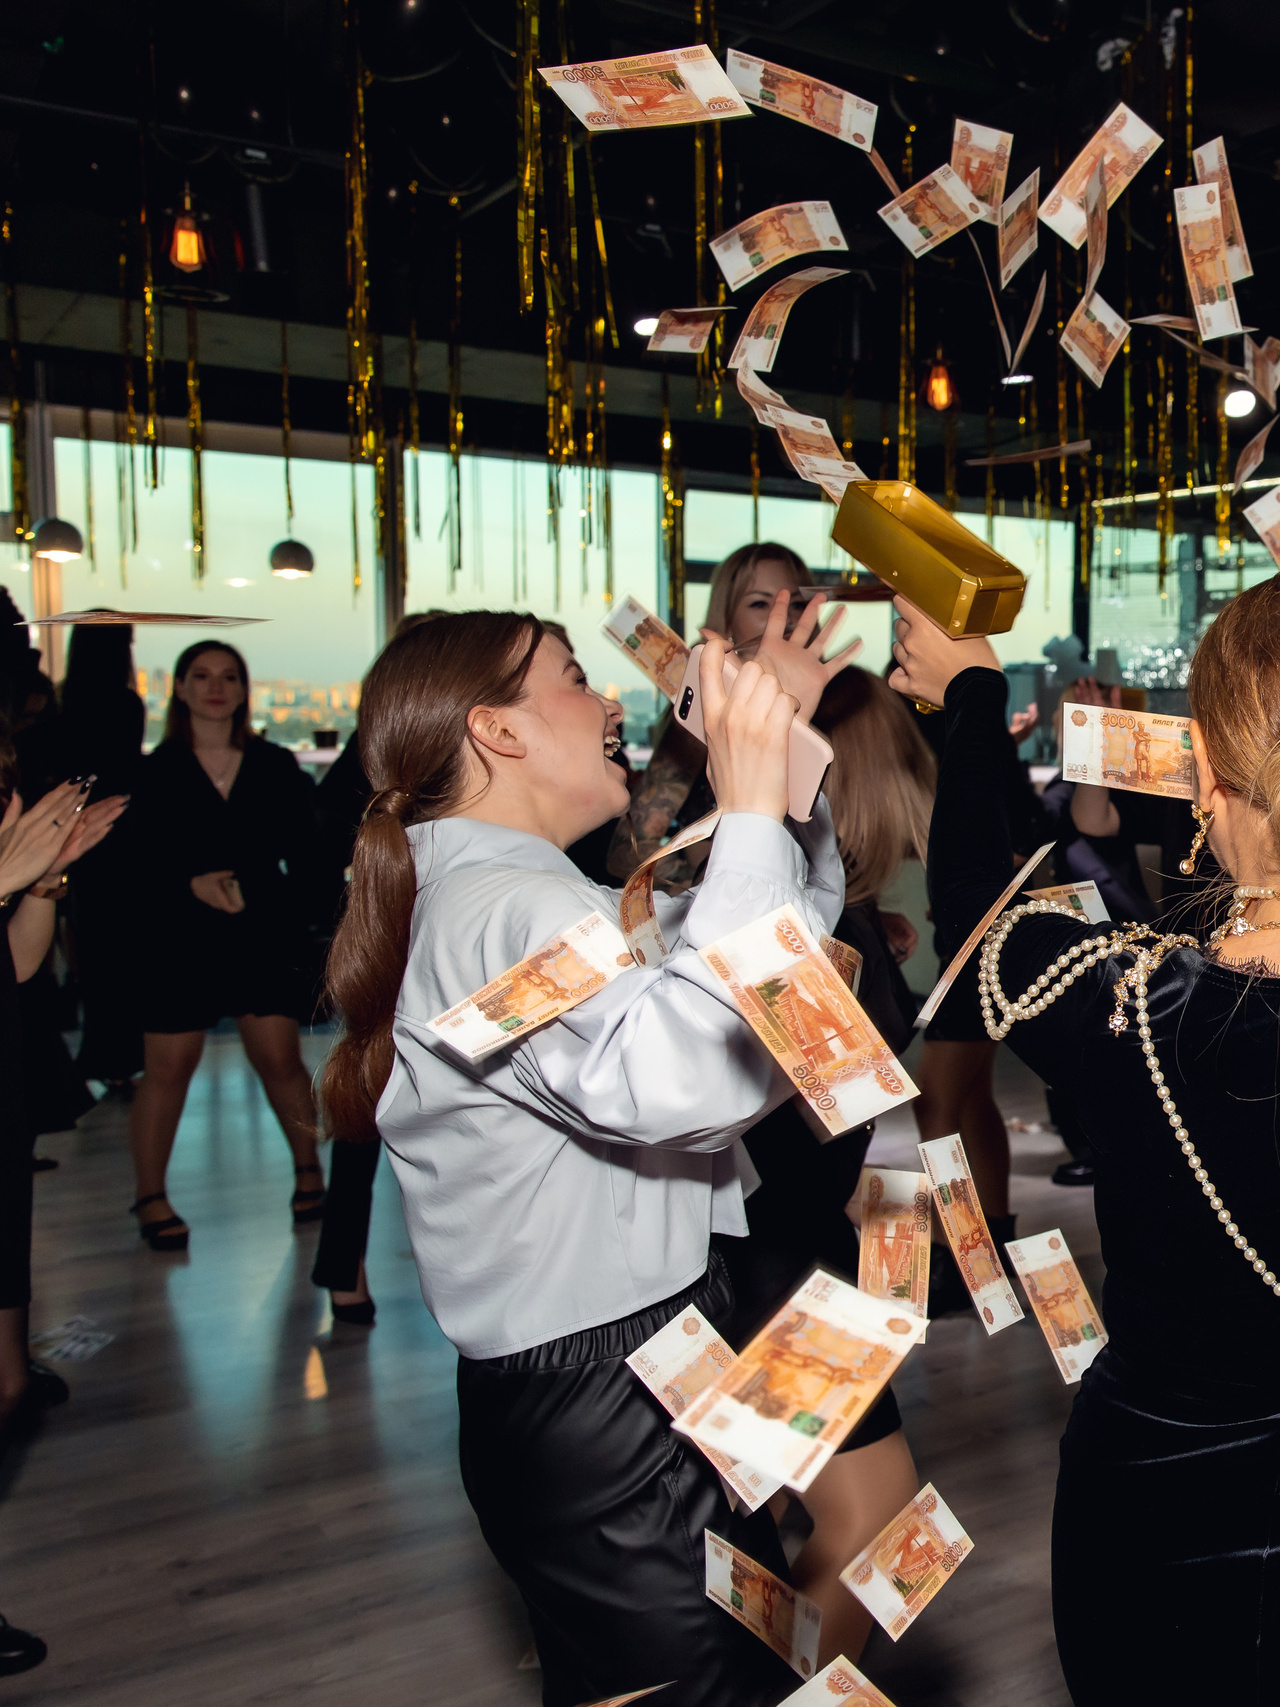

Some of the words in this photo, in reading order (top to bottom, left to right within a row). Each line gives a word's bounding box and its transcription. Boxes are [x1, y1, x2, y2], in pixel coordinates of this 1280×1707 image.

[561, 65, 607, 83] 5000
[706, 99, 737, 110] 5000
[587, 115, 612, 123] 5000
[1123, 145, 1149, 177] 5000
[1099, 712, 1136, 729] 5000
[1151, 718, 1174, 726] БИЛЕТ
[777, 921, 805, 954] 5000
[707, 952, 732, 980] ПЯТЬ
[569, 972, 607, 999] 5000
[510, 1019, 535, 1035] БАНКА
[791, 1061, 837, 1111] 5000
[877, 1064, 902, 1093] 5000
[912, 1191, 928, 1232] 5000
[705, 1339, 733, 1369] 500
[920, 1494, 935, 1511] 5000
[939, 1541, 963, 1570] 5000
[829, 1671, 853, 1693] 5000
